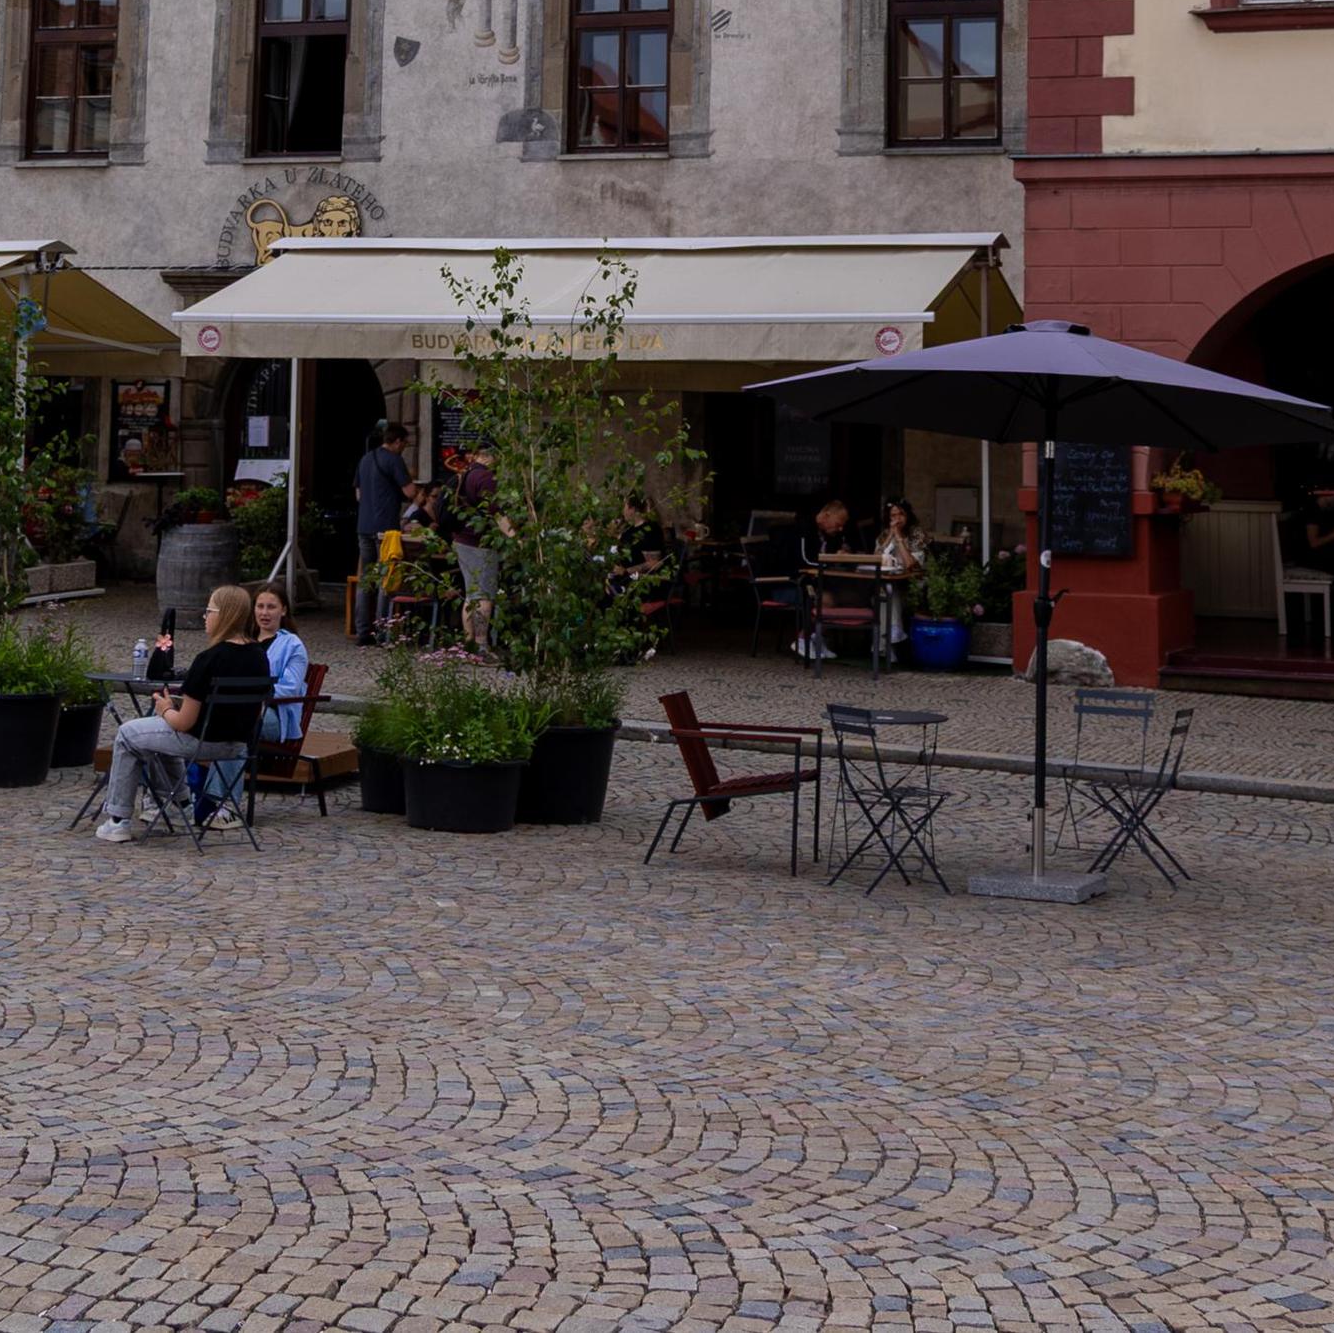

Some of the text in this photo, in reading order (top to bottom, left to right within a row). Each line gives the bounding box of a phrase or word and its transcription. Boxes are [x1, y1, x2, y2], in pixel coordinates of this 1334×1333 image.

[216, 165, 385, 268] BUDVARKA U ZLATÉHO
[628, 334, 666, 352] LVA
